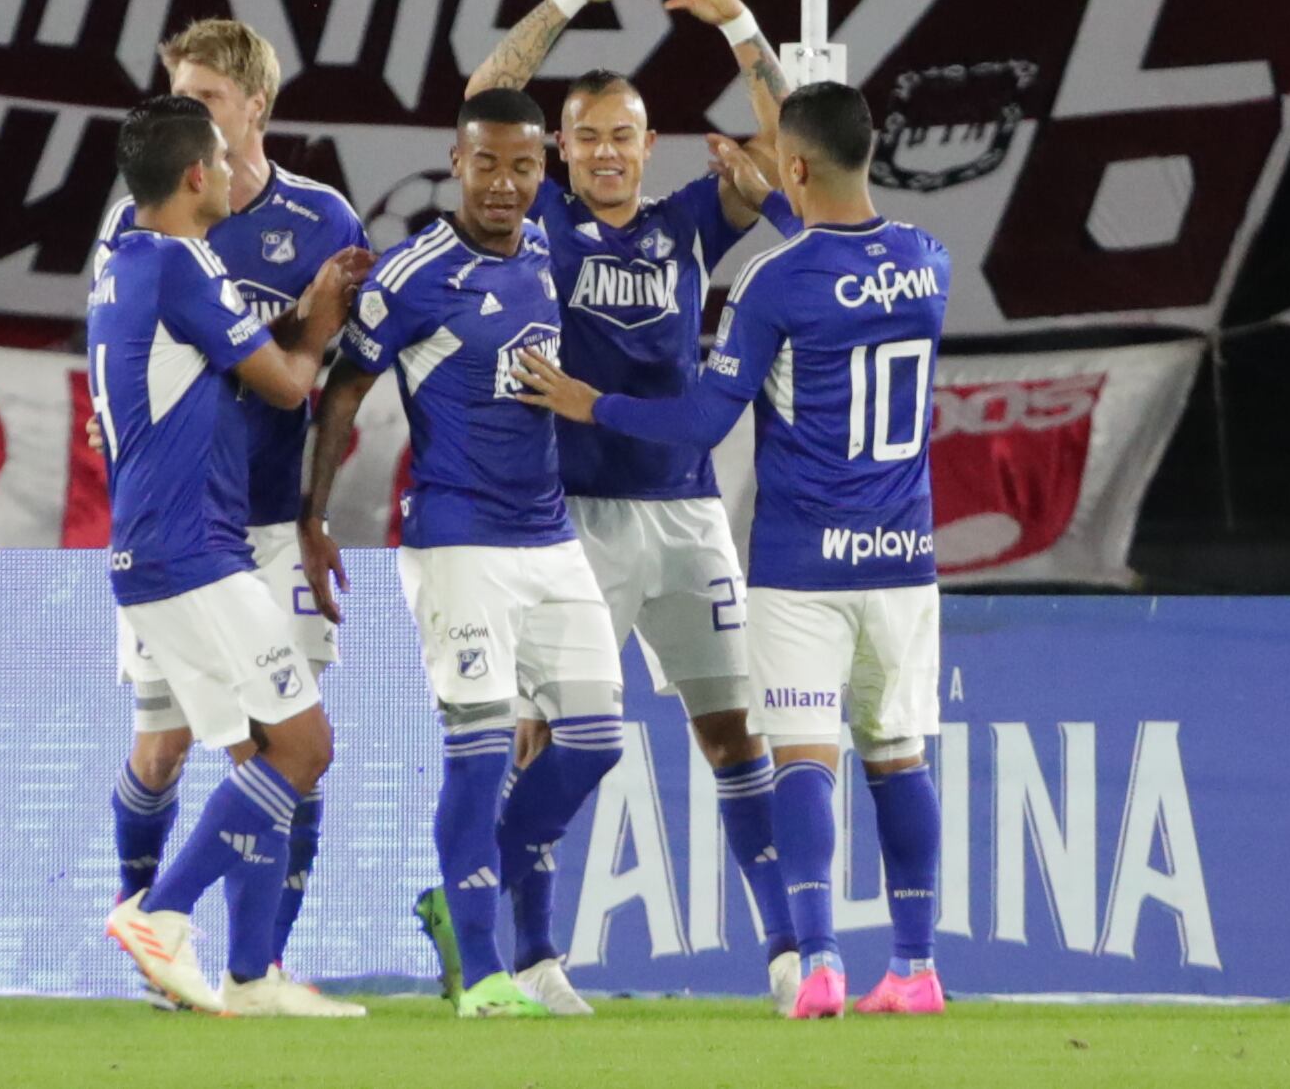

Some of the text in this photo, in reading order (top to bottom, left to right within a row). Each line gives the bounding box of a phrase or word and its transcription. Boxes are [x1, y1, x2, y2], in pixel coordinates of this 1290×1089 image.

[848, 338, 932, 462] 10
[708, 575, 748, 632] 2
[764, 687, 836, 708] Allianz
